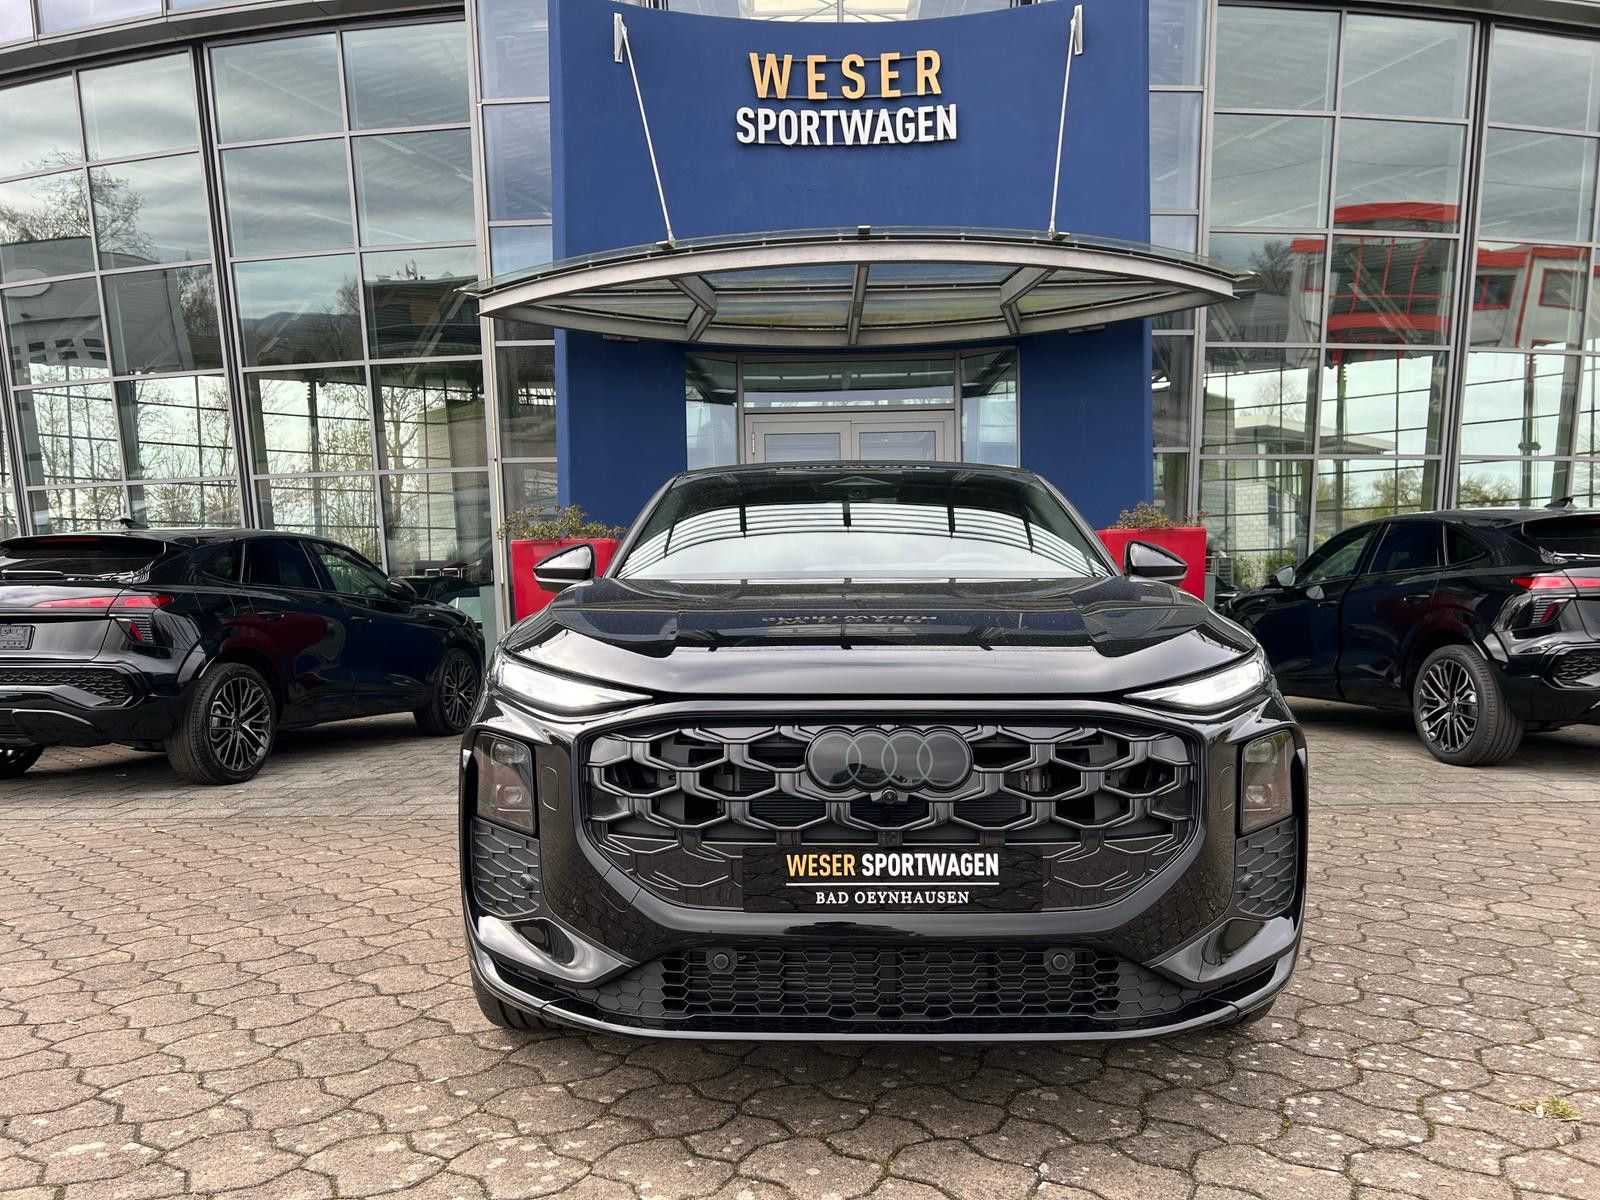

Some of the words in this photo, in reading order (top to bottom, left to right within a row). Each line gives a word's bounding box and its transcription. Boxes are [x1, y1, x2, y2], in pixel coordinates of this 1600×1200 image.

[749, 50, 942, 100] WESER
[736, 104, 957, 145] SPORTWAGEN
[786, 853, 856, 877] WESER
[861, 853, 999, 877] SPORTWAGEN
[815, 891, 849, 904] BAD
[854, 891, 970, 904] OEYNHAUSEN
